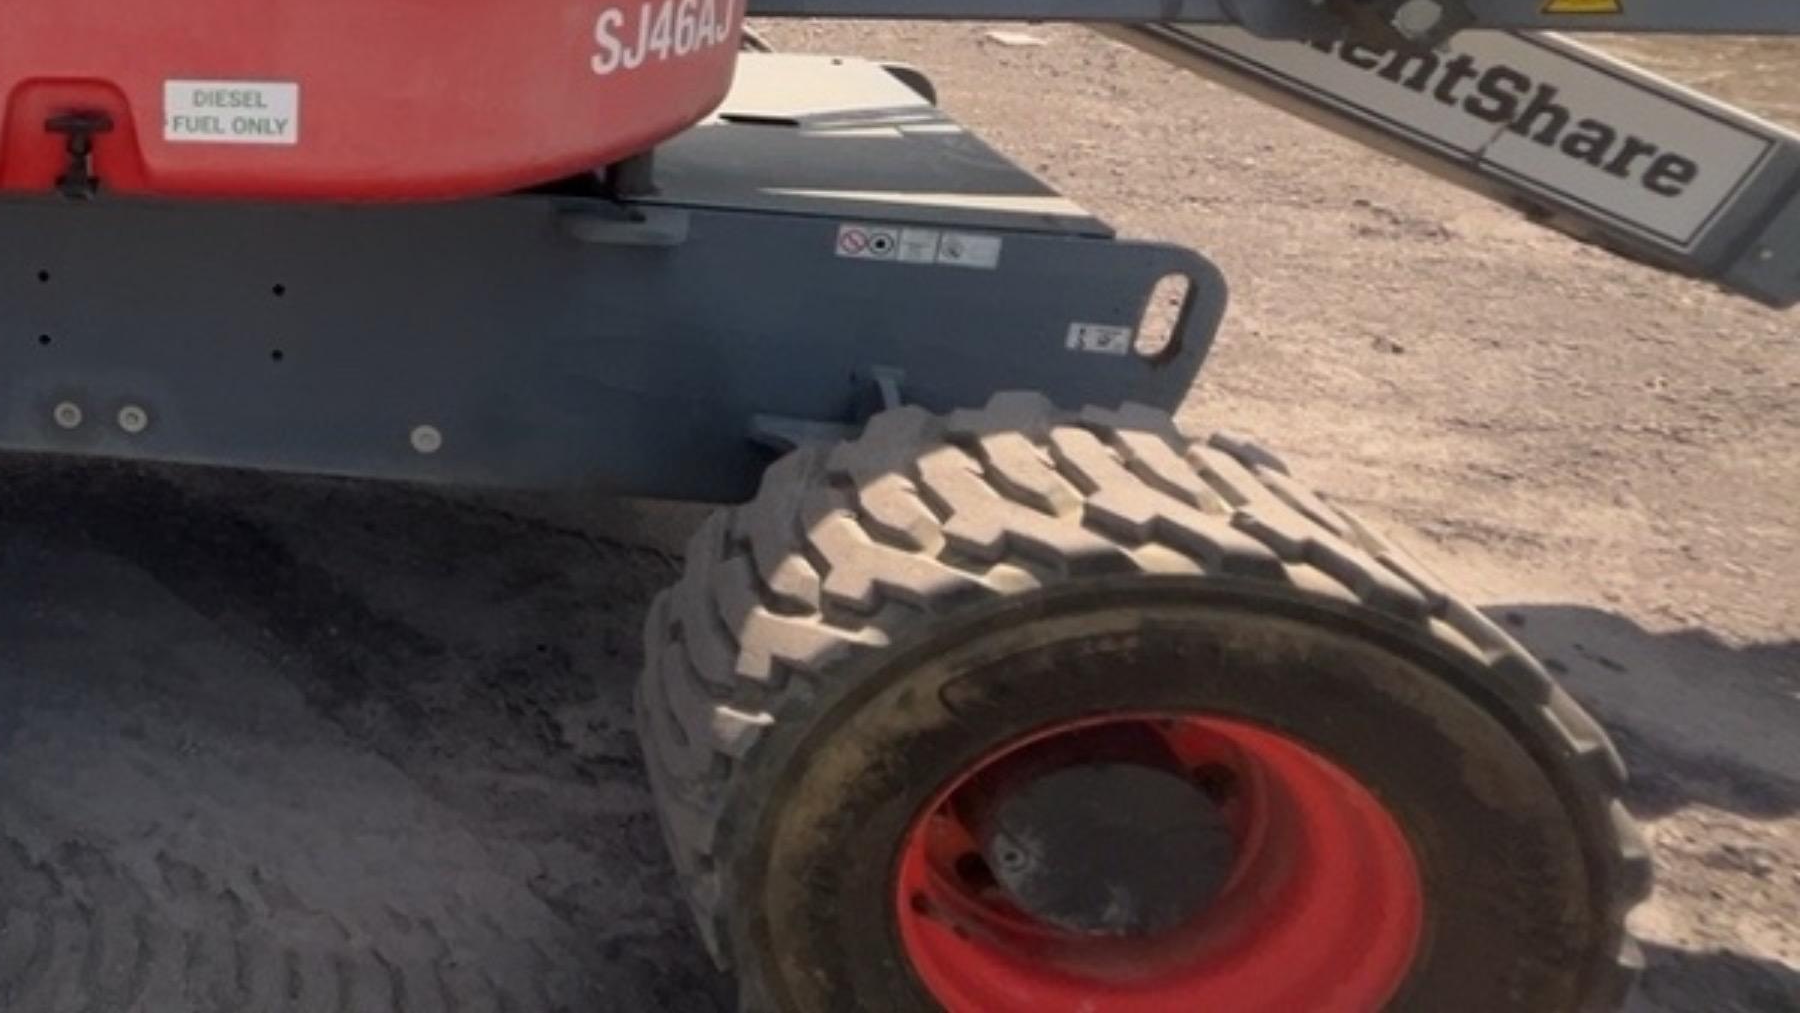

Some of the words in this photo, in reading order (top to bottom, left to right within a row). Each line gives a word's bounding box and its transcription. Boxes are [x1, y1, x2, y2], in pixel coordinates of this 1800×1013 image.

[192, 88, 267, 109] DIESEL
[172, 114, 226, 134] FUEL
[231, 115, 289, 135] ONLY
[1306, 38, 1698, 198] entShare
